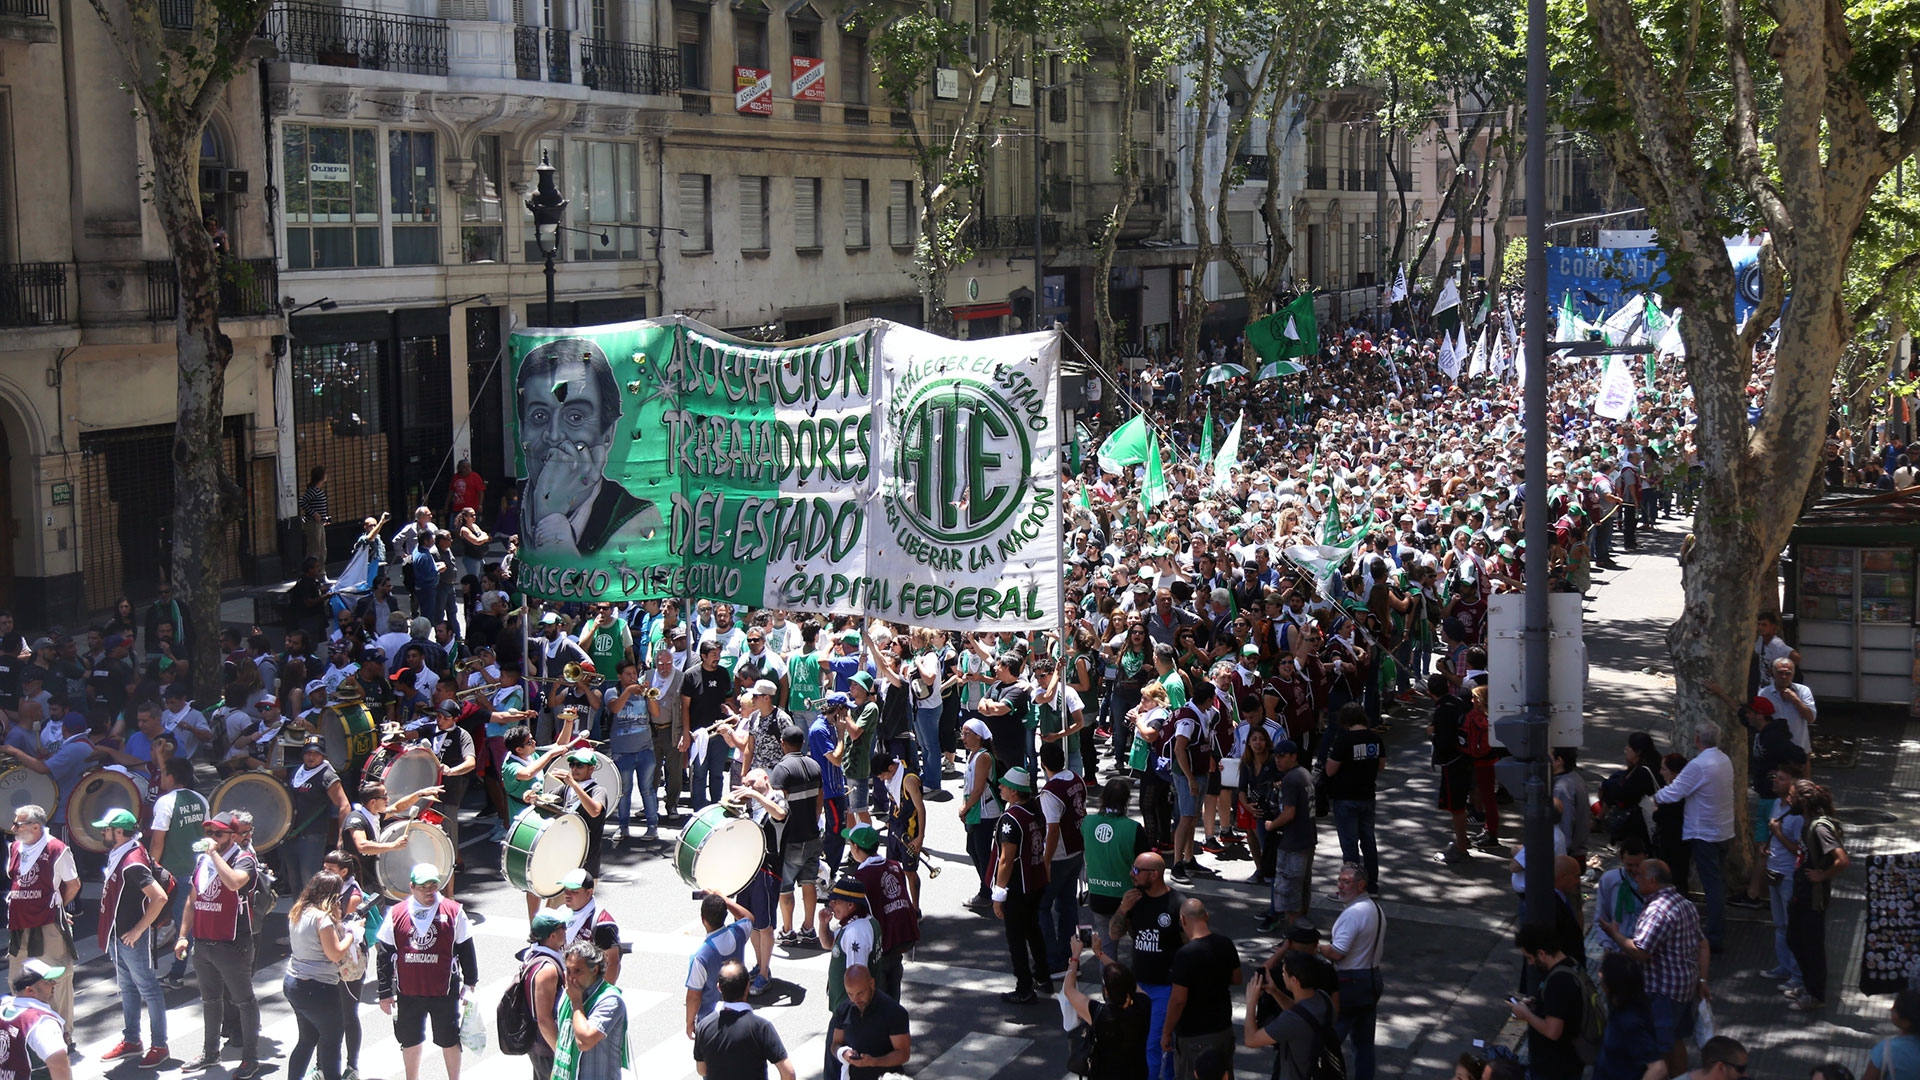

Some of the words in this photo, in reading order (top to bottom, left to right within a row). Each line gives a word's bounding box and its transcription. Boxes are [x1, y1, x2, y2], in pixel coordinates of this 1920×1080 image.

[793, 59, 810, 68] VENDE
[738, 68, 756, 78] VENDE
[971, 356, 995, 375] EL
[994, 364, 1048, 432] ESTADO
[662, 408, 873, 484] TRABAJADORES
[900, 392, 1010, 530] ATE
[670, 491, 725, 558] DEL
[732, 495, 865, 564] ESTADO
[896, 527, 964, 572] LIBERAR
[969, 544, 995, 572] LA
[998, 487, 1056, 562] NACION
[779, 571, 894, 614] CAPITAL
[898, 581, 1046, 622] FEDERAL
[596, 635, 612, 650] ATE
[180, 805, 190, 815] PAZ
[1096, 825, 1112, 841] ATE
[1089, 878, 1122, 888] NEUQUEN
[1141, 931, 1160, 942] SON
